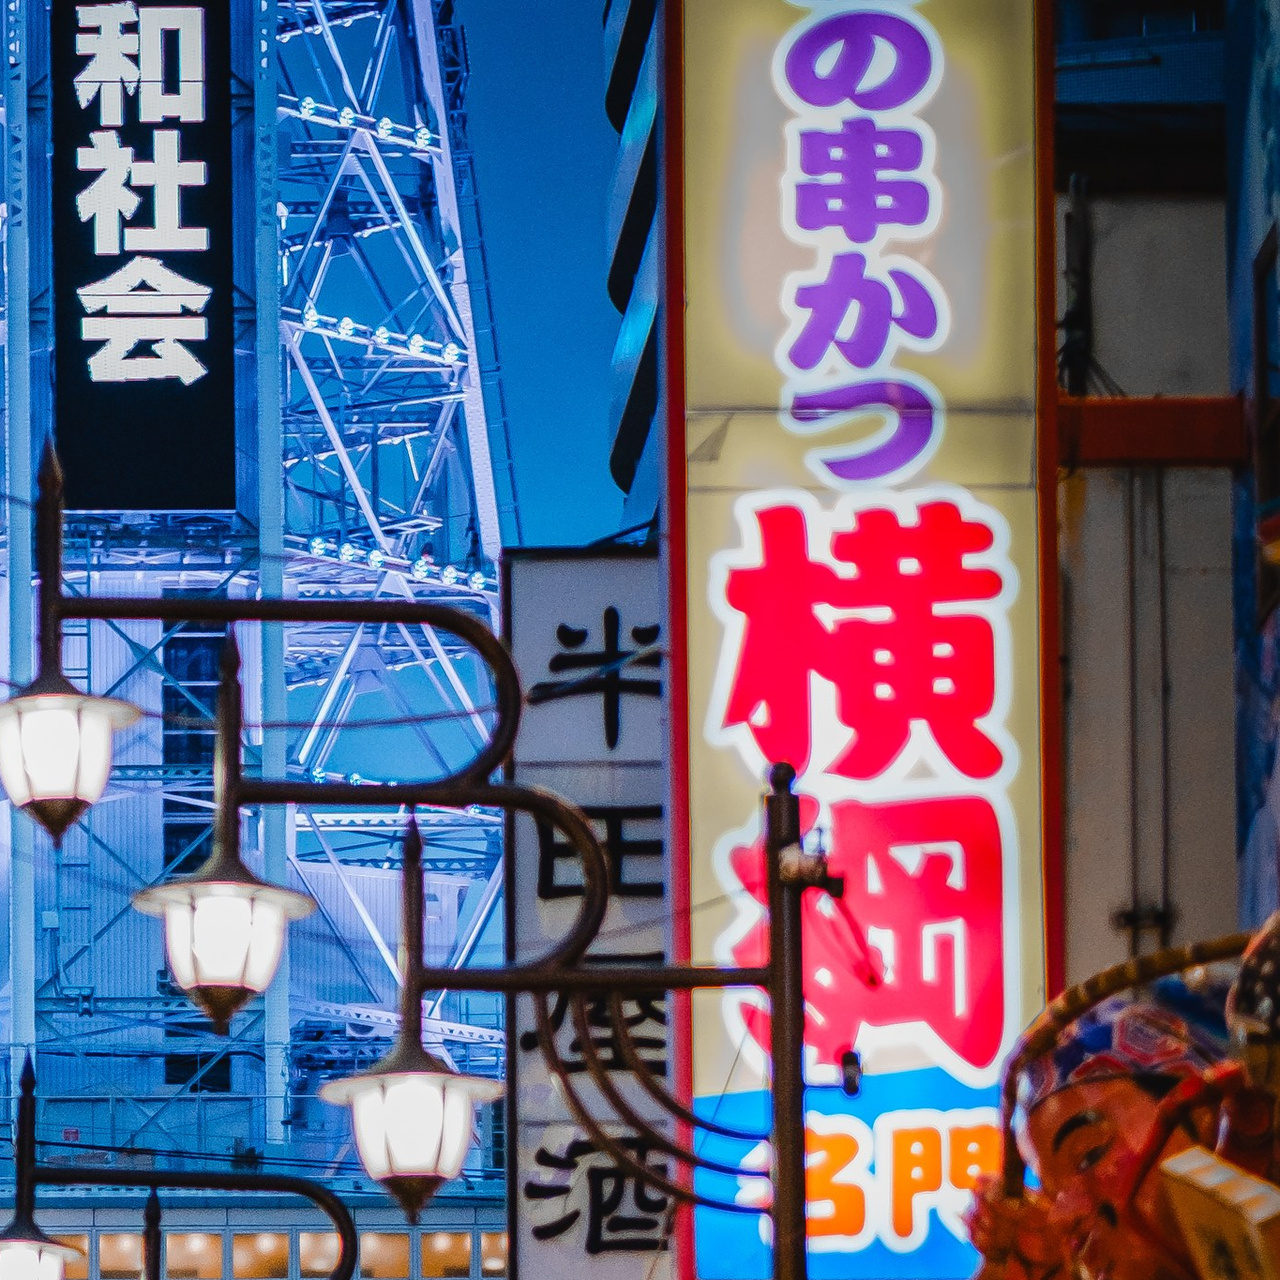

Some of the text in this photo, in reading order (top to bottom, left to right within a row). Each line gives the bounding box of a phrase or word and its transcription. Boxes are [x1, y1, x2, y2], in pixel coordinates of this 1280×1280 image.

[74, 2, 212, 386] 和社会
[783, 10, 940, 482] の串かつ
